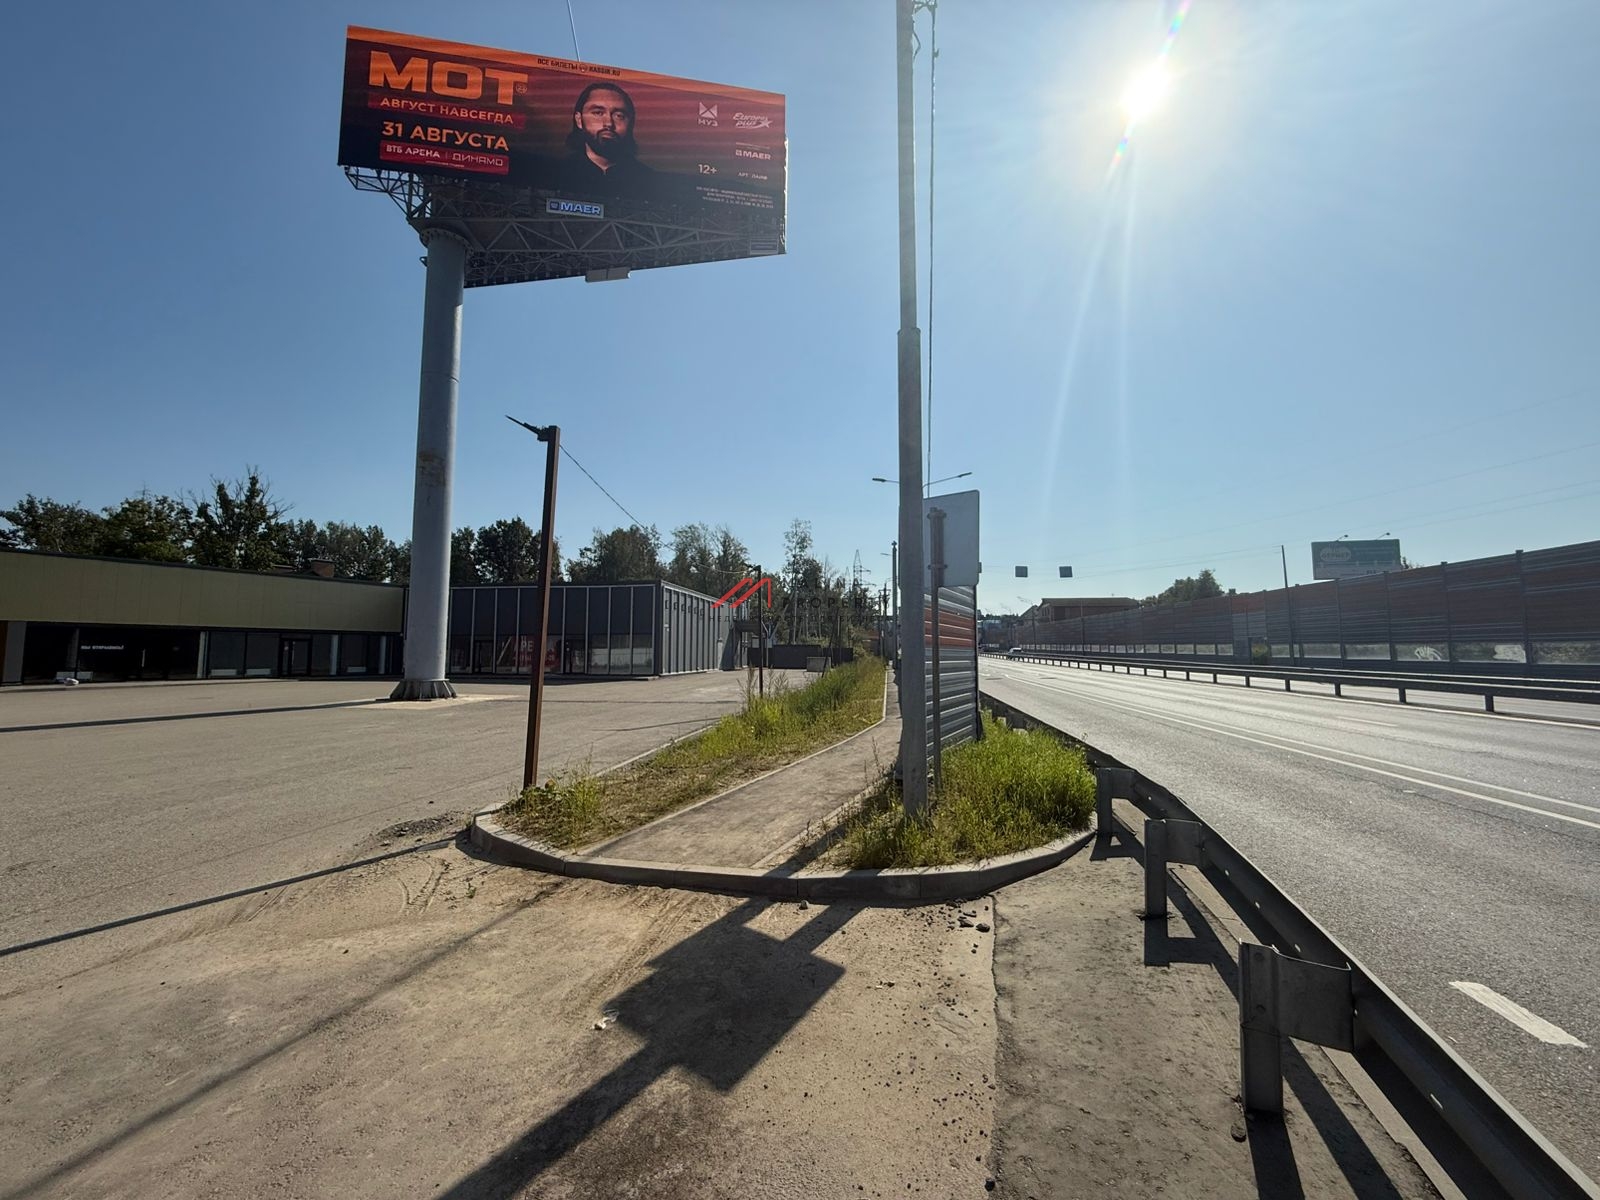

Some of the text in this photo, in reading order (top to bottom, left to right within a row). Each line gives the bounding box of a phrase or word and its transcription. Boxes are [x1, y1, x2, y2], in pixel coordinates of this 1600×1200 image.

[537, 58, 578, 70] ВСЕ БИЛЕТЫ
[368, 50, 529, 106] МОТ
[379, 97, 514, 125] АВГУСТ НАВСЕГДА
[381, 121, 510, 151] 31 АВГУСТА
[386, 144, 403, 154] ВТБ
[404, 147, 441, 159] АРЕНА
[451, 153, 504, 167] ДИНАМО
[743, 150, 771, 160] MAER
[698, 163, 717, 175] 12+
[560, 201, 601, 215] MAER
